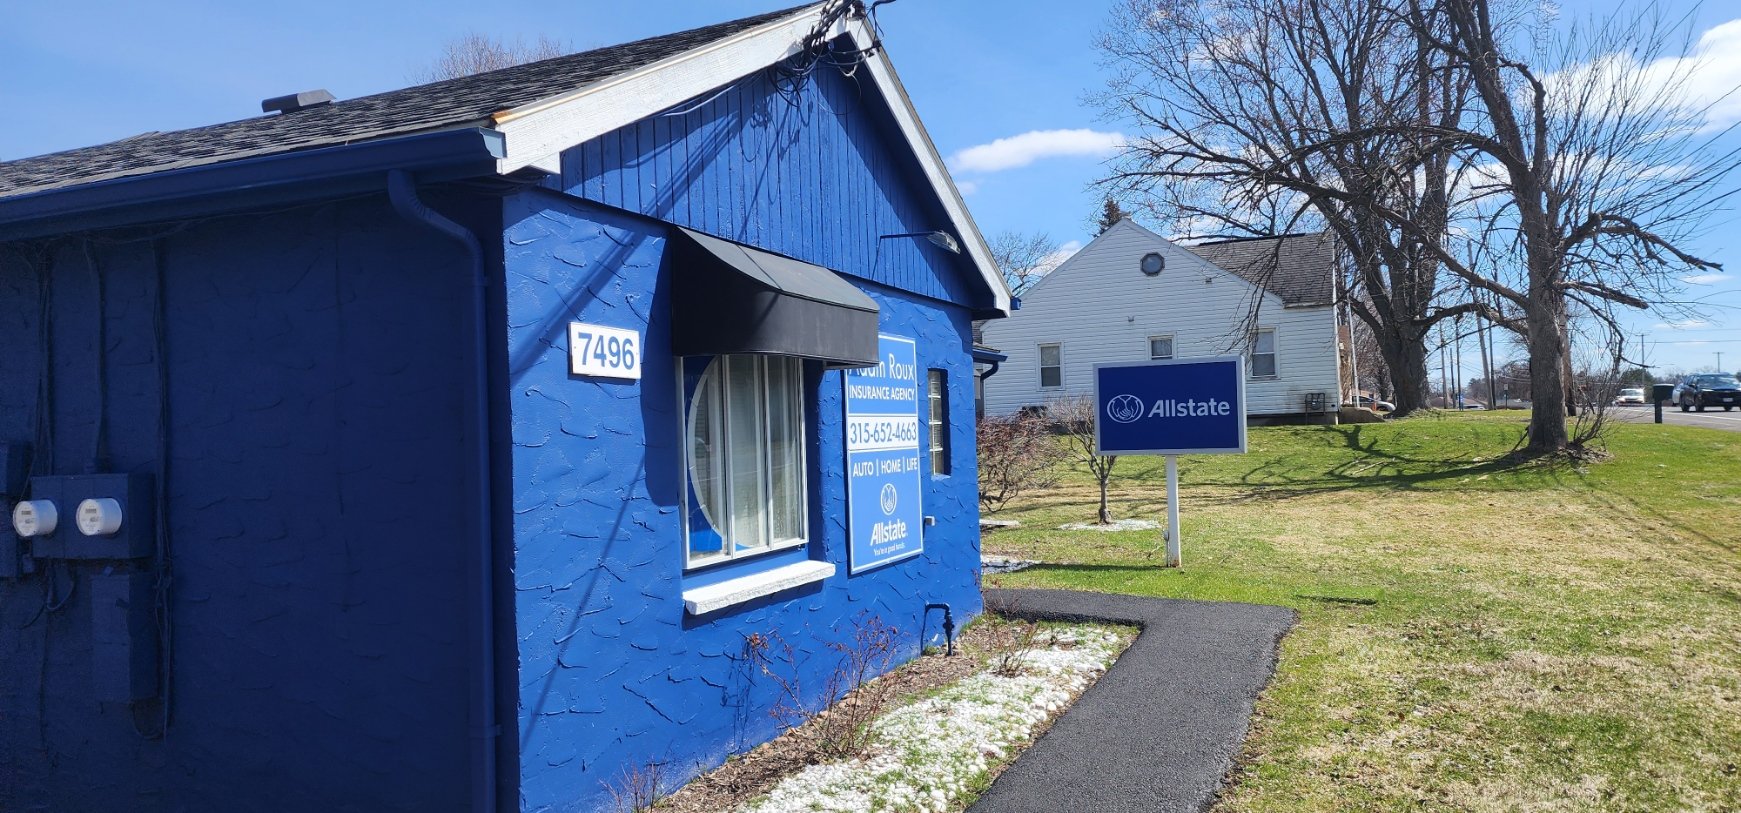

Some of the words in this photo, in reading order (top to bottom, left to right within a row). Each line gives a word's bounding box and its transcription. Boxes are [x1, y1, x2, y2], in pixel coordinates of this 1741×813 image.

[578, 332, 635, 370] 7496
[888, 352, 915, 381] Roux
[849, 384, 890, 400] INSURANCE
[890, 387, 915, 401] AGENCY
[1148, 398, 1231, 418] Allstate
[850, 421, 917, 444] 315-652-4663
[852, 461, 874, 478] AUTO
[880, 458, 902, 475] HOME
[906, 457, 918, 471] LIFE
[870, 518, 906, 547] Allstate
